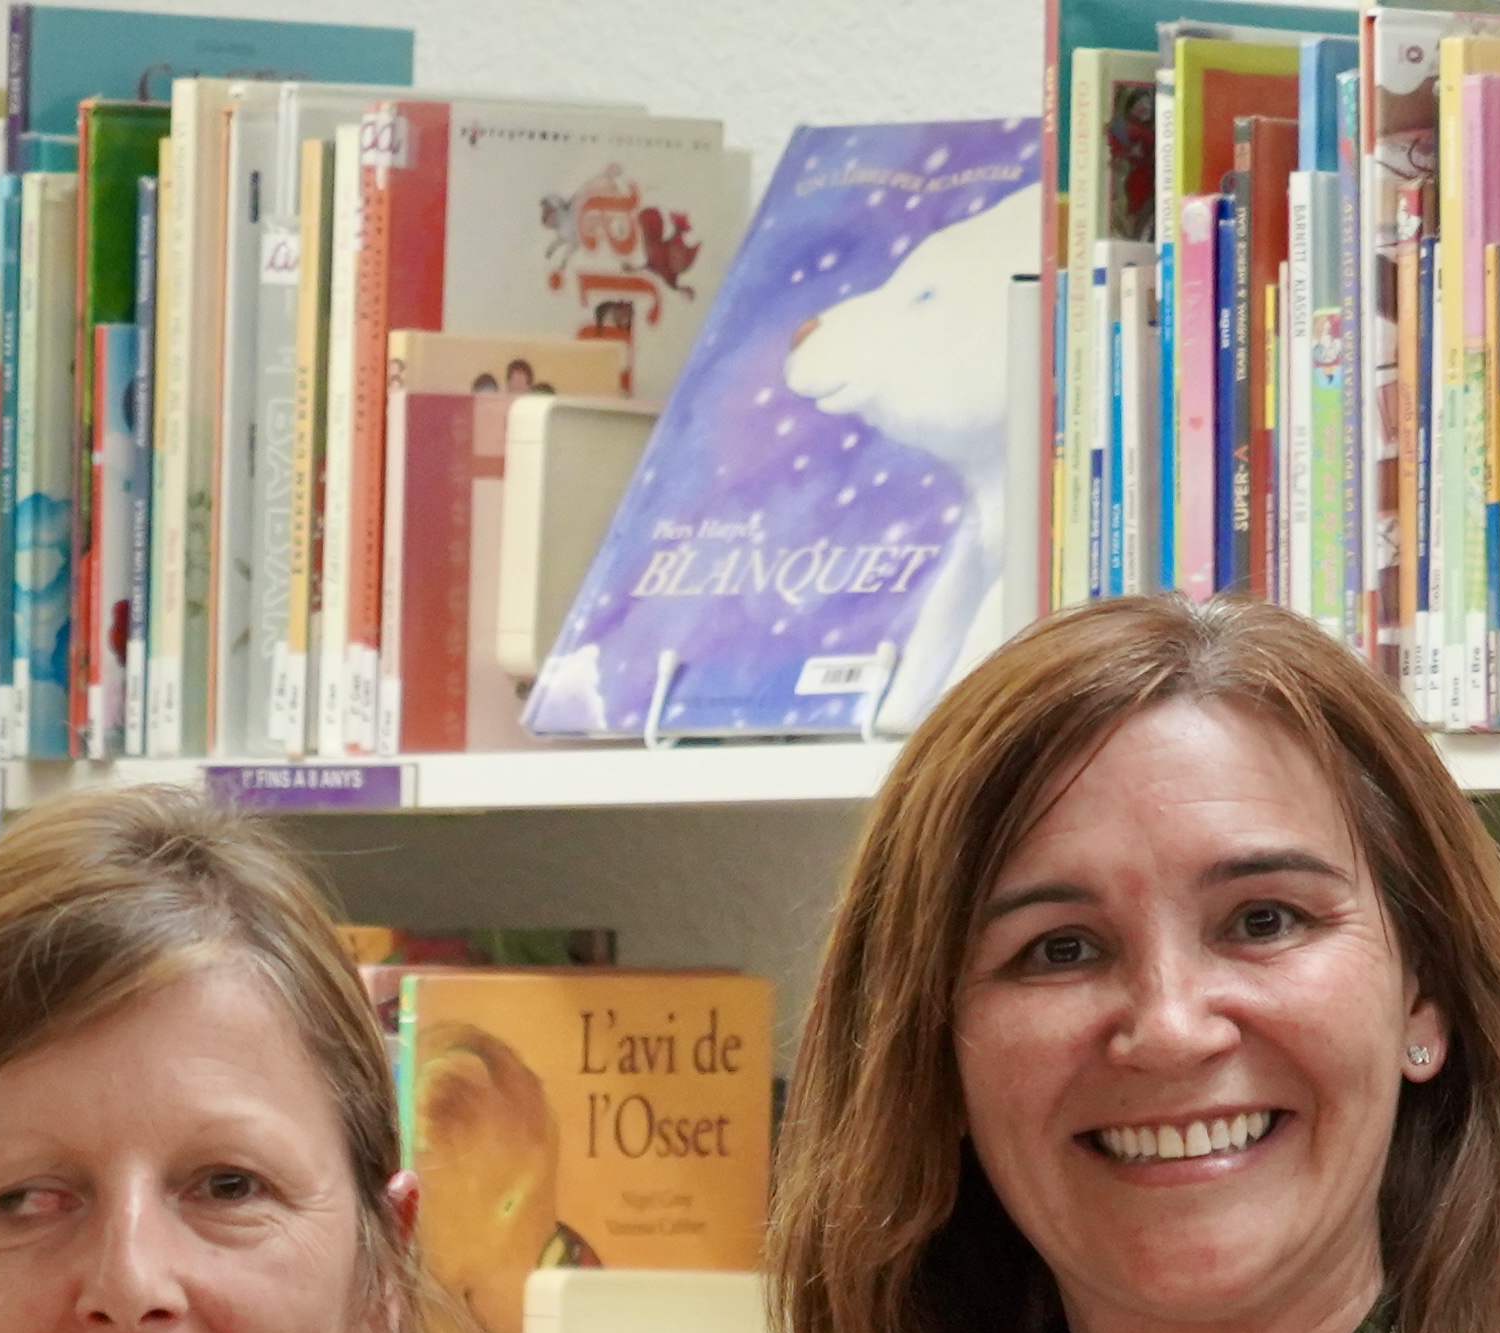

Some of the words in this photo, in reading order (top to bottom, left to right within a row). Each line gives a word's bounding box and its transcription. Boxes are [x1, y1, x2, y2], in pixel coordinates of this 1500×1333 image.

[1298, 204, 1308, 264] BARNETT
[1294, 282, 1308, 337] KLASSEN
[630, 544, 943, 605] BLANQUET
[578, 1009, 676, 1076] L'avi
[693, 1008, 743, 1076] de
[586, 1093, 731, 1160] l'Osset
